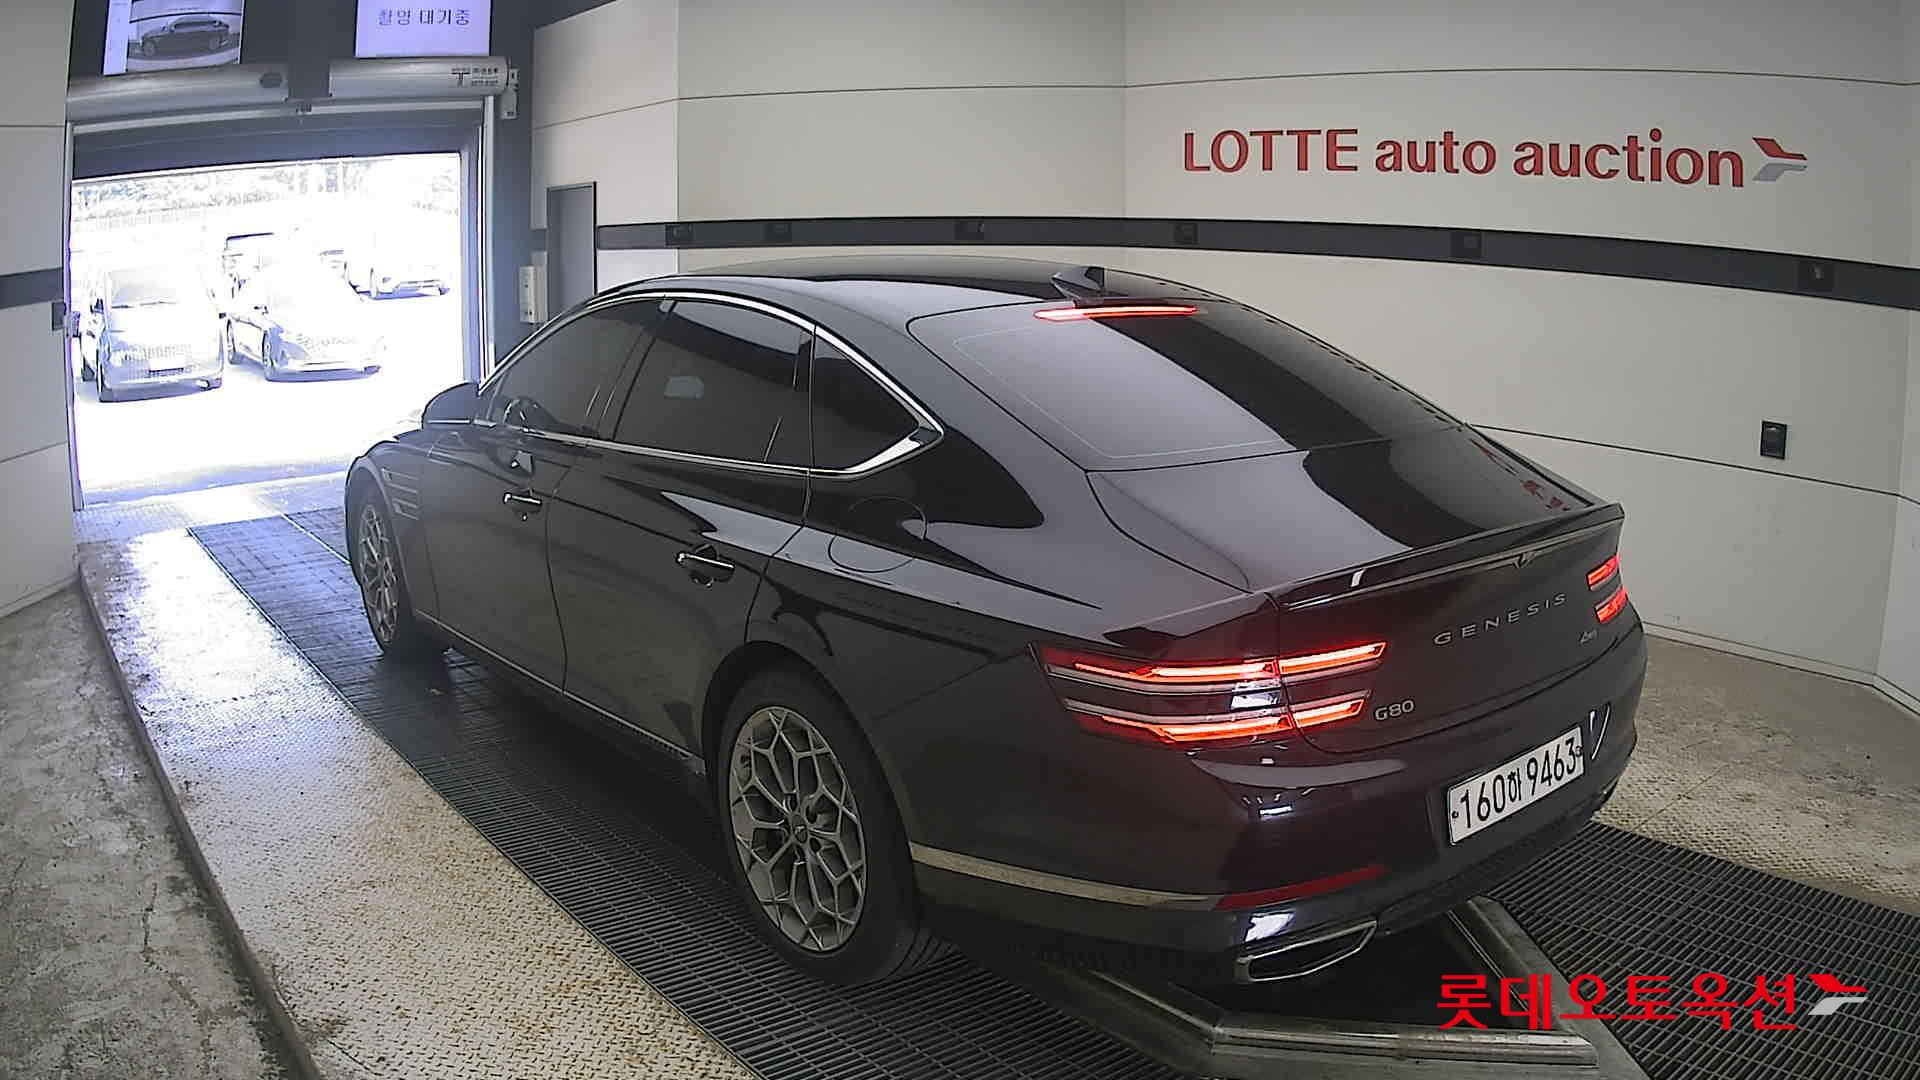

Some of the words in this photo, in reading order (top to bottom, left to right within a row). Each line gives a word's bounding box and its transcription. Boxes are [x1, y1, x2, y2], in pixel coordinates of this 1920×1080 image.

[419, 9, 470, 26] 대기중
[1184, 128, 1359, 173] LOTTE
[1375, 130, 1497, 175] auto
[1513, 127, 1744, 188] auction
[1433, 593, 1567, 646] GENESIS
[1374, 699, 1416, 722] G80
[1459, 767, 1522, 829] 160하
[1526, 736, 1577, 796] 9463
